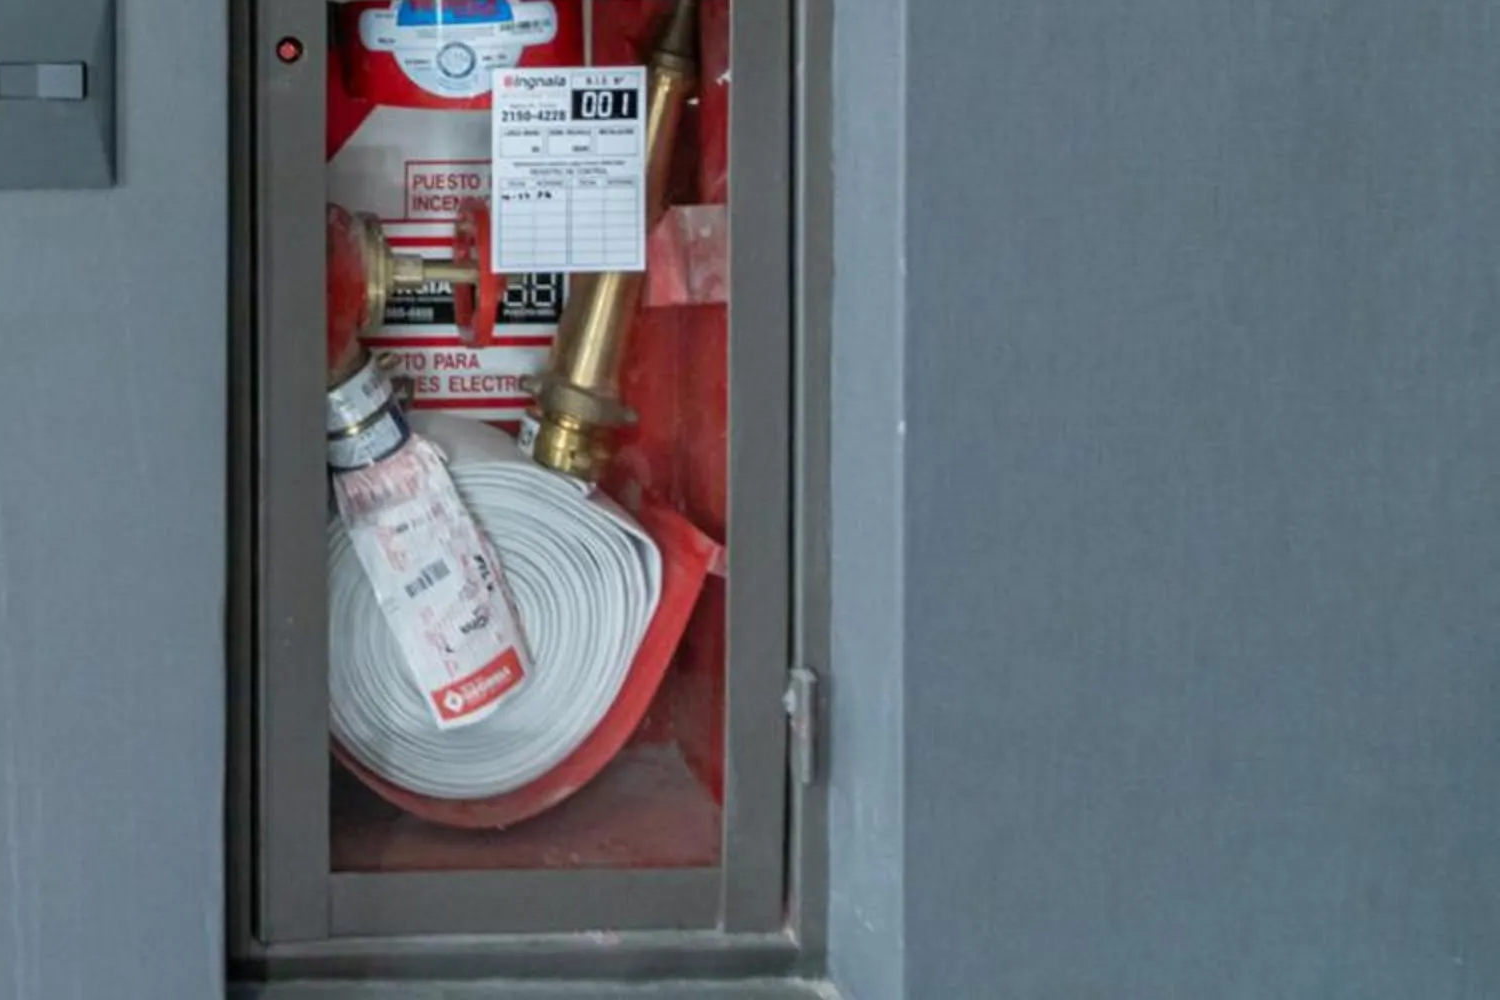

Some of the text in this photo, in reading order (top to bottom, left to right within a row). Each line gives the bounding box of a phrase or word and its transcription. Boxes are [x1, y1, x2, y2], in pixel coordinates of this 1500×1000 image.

[582, 92, 630, 117] 001
[412, 173, 481, 190] PUESTO
[433, 353, 481, 370] PARA
